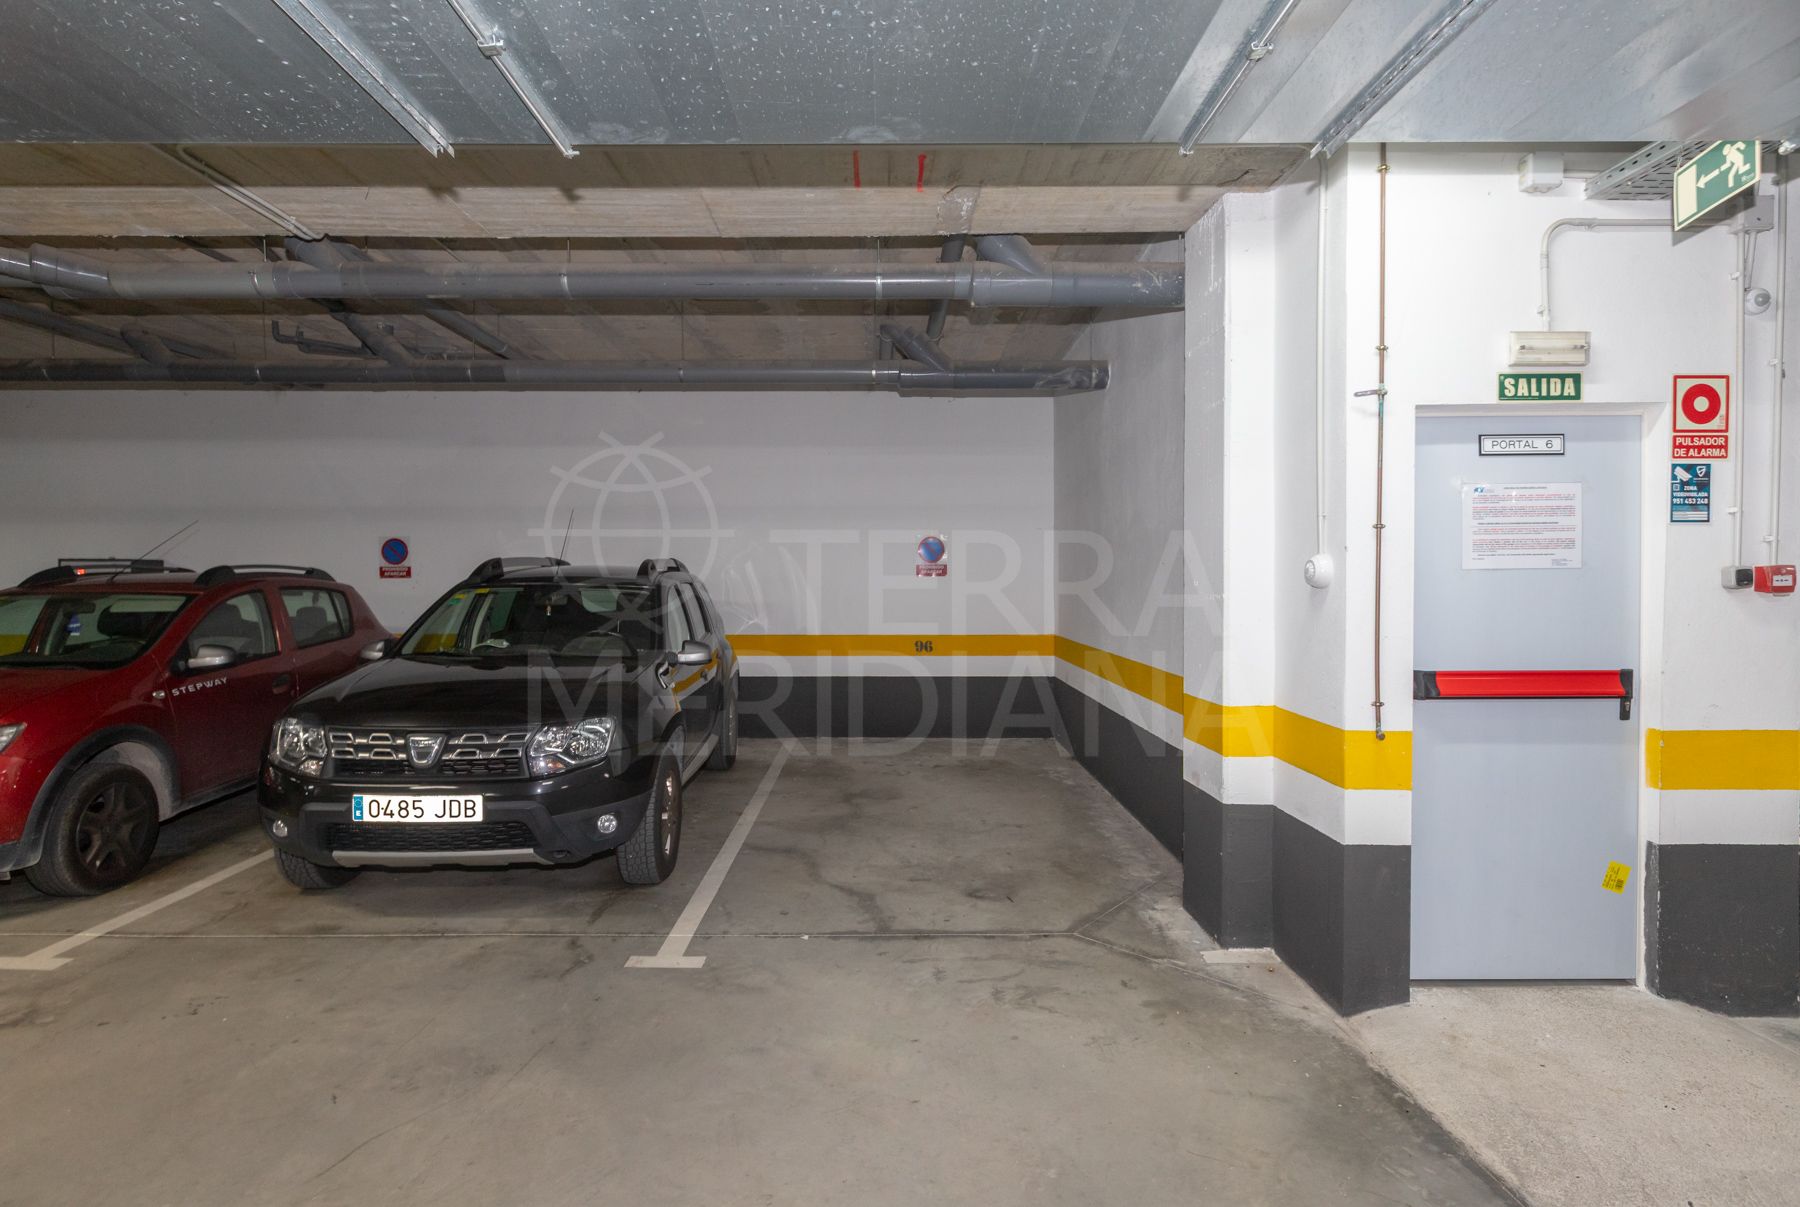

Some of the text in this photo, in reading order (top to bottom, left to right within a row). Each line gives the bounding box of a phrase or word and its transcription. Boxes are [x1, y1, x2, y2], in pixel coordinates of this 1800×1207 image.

[1503, 377, 1576, 397] SALIDA
[1491, 440, 1554, 449] PORTAL 6
[1675, 437, 1726, 446] PULSADOR
[1674, 448, 1727, 457] DE ALARMA
[915, 640, 933, 652] 96
[172, 677, 227, 697] STEPWAY
[368, 799, 476, 818] 0485 JDB
